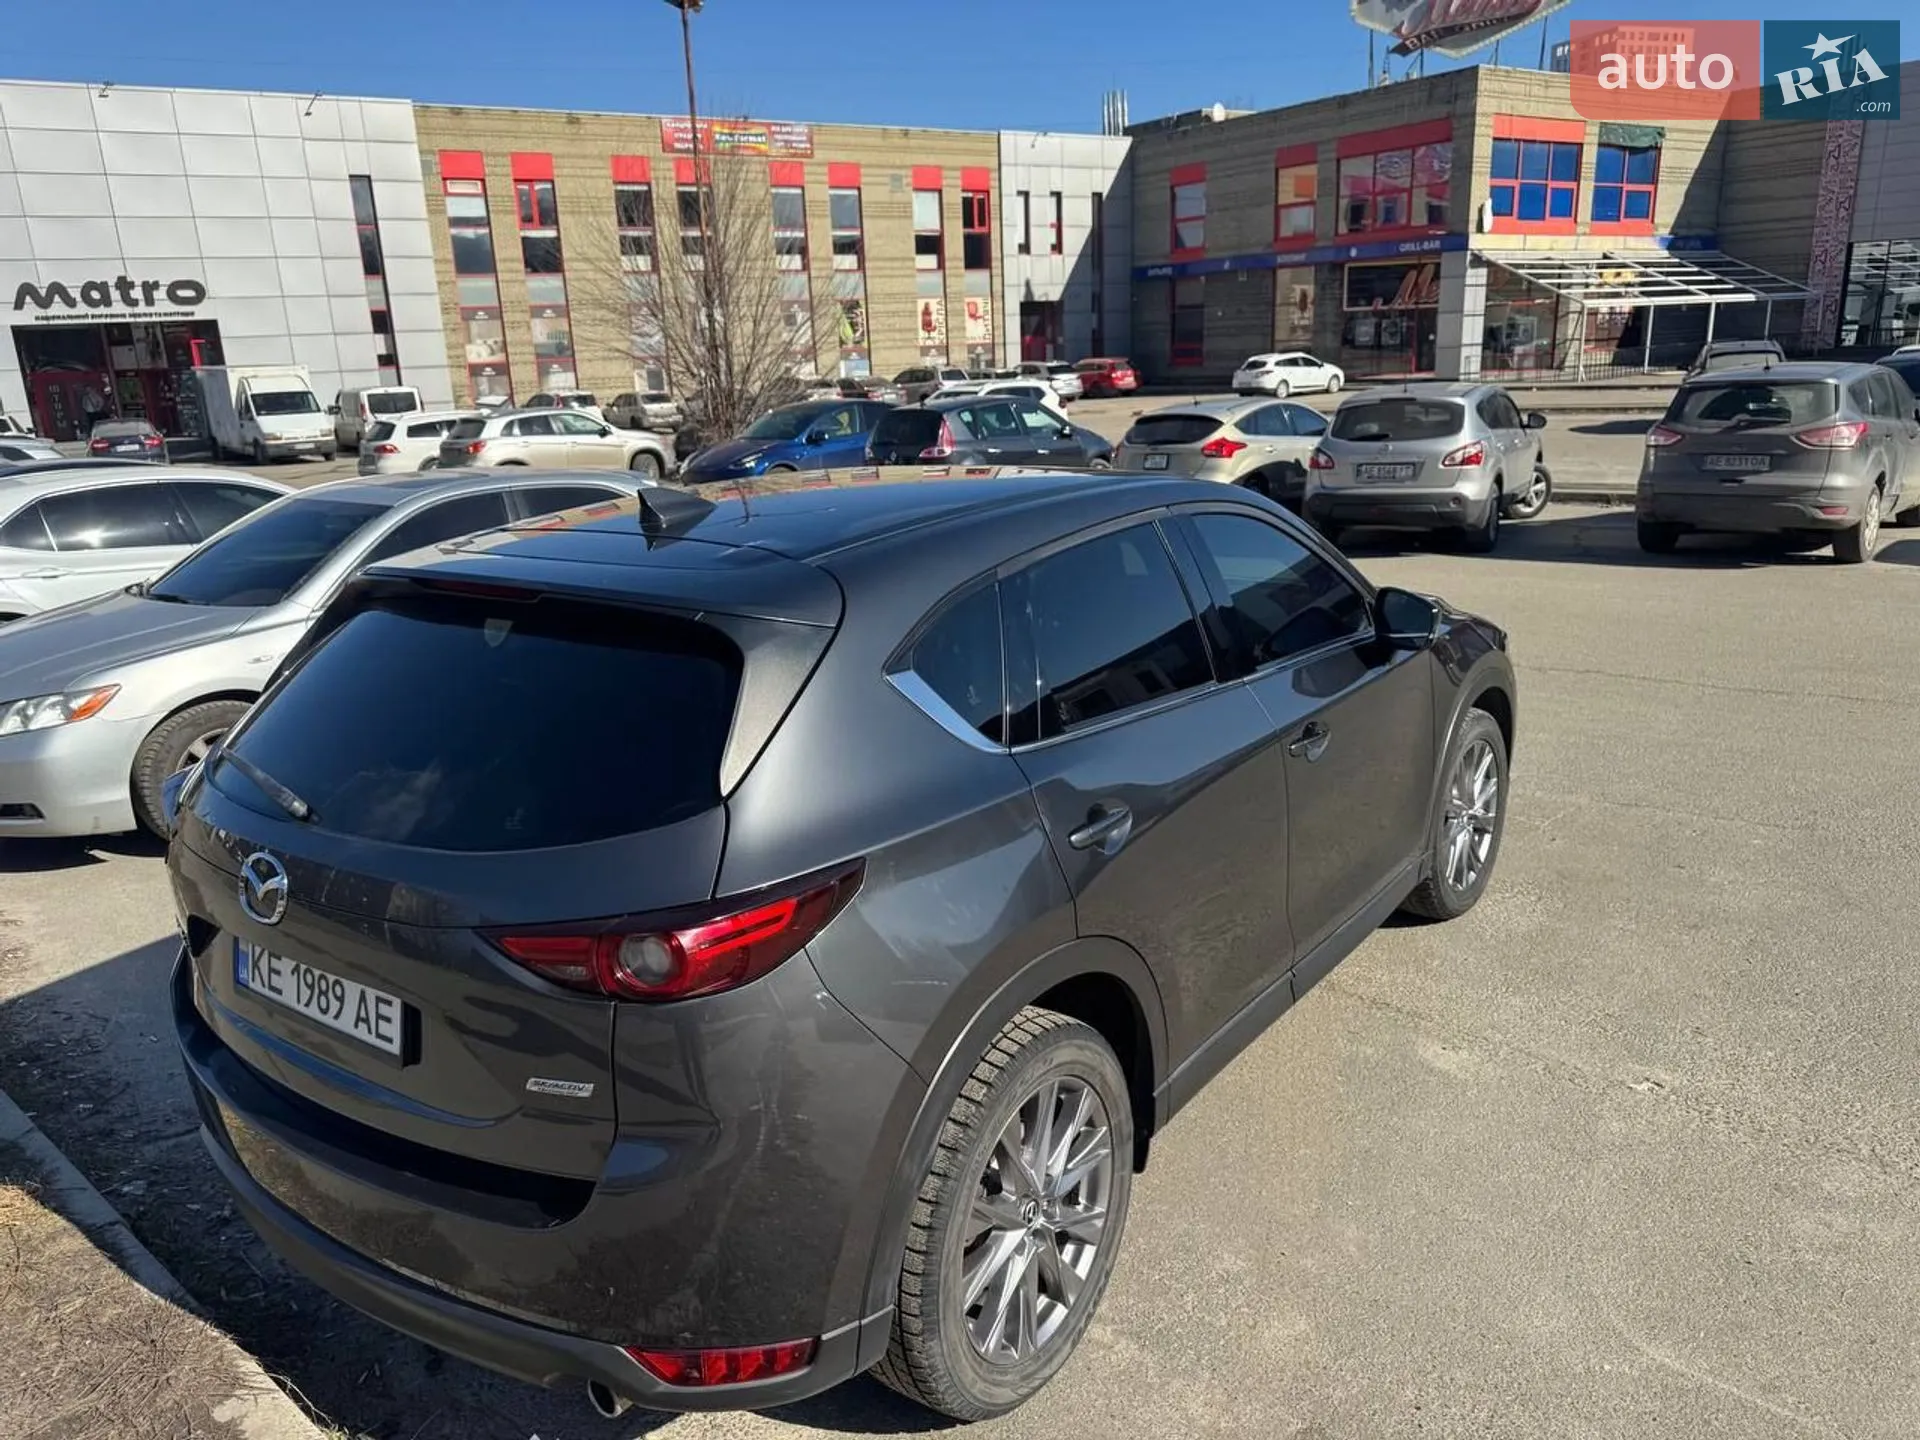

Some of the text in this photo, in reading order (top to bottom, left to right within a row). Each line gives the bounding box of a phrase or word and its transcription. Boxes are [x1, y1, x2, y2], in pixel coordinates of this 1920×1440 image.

[251, 943, 394, 1045] KE 1989 AE
